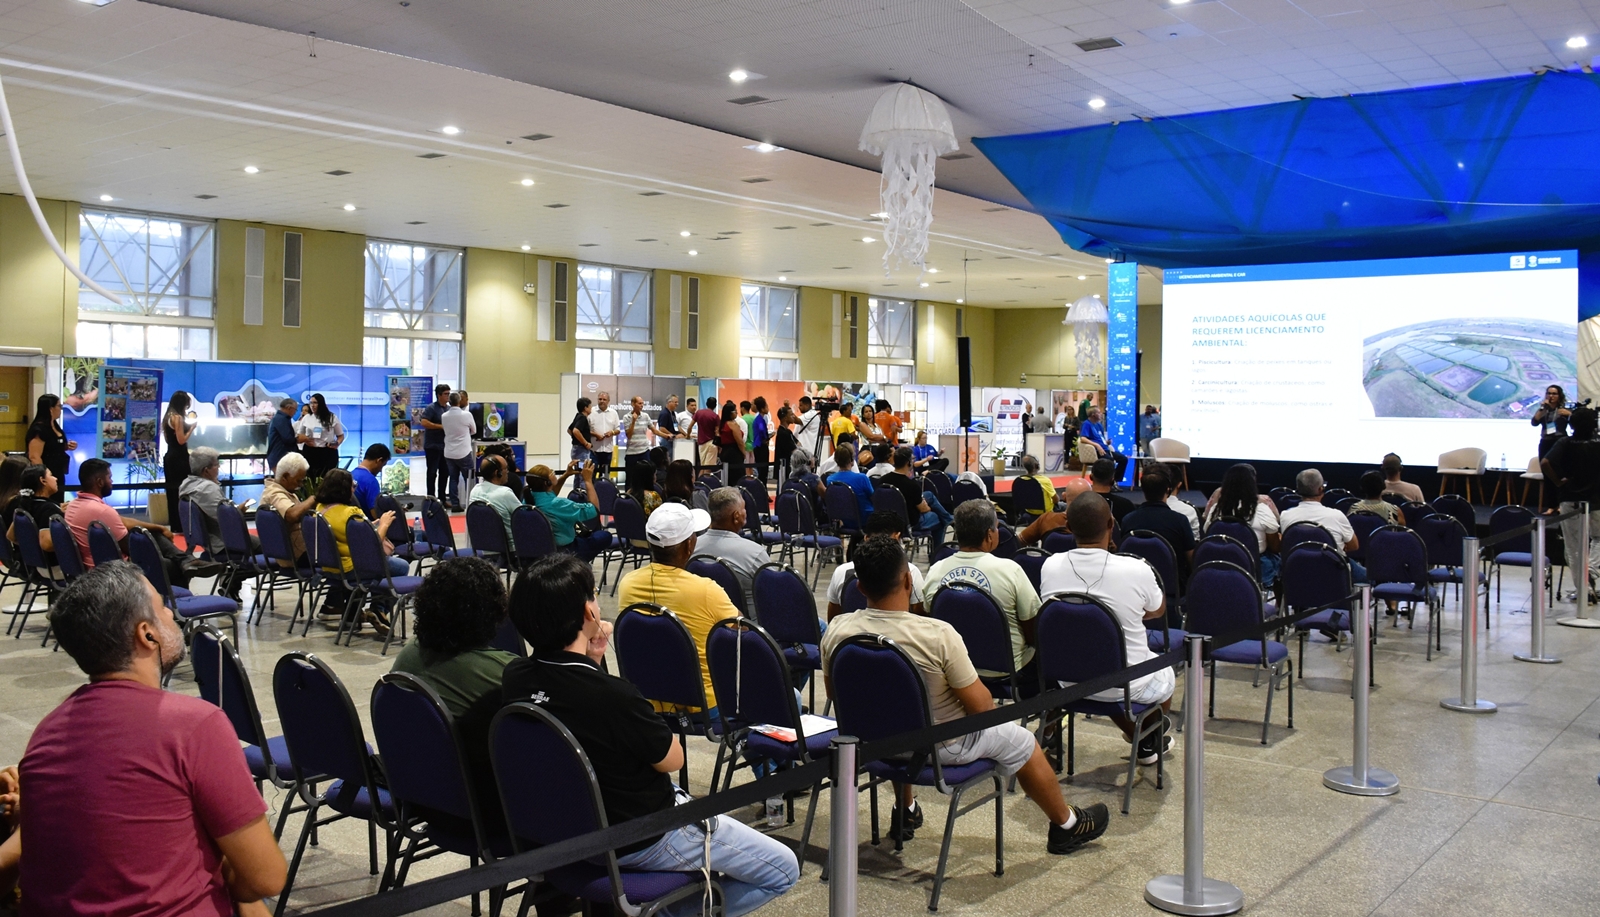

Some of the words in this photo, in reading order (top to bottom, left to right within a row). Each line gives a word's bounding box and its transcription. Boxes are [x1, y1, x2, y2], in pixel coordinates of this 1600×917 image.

[1192, 315, 1245, 323] ATIVIDADES
[1248, 313, 1303, 322] AQUÍCOLAS
[1305, 313, 1326, 321] QUE
[1192, 327, 1243, 335] REQUEREM
[1246, 325, 1325, 335] LICENCIAMENTO
[1192, 339, 1248, 347] AMBIENTAL:
[970, 570, 989, 588] STAT
